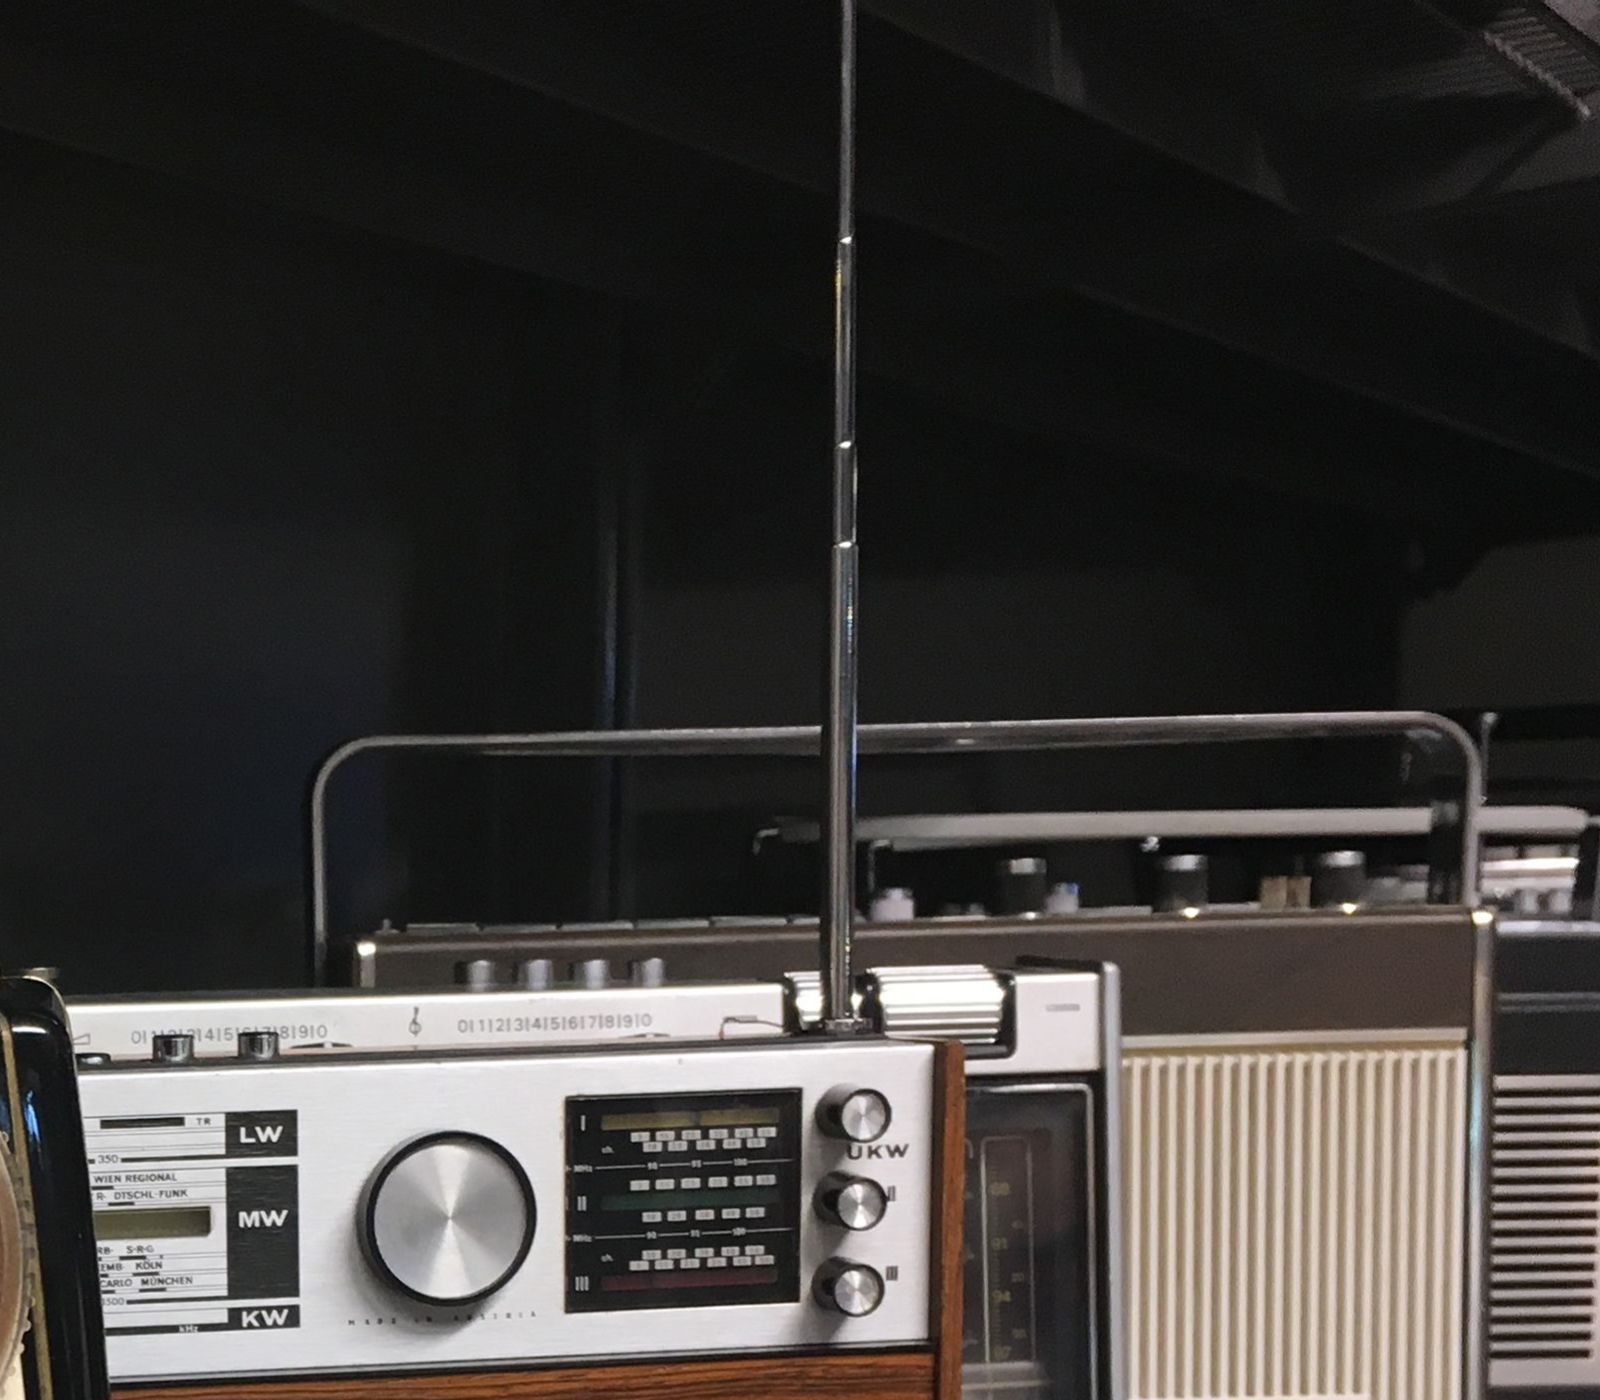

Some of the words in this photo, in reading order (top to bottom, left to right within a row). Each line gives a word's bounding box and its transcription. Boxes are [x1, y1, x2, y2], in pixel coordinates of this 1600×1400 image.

[240, 1125, 284, 1144] LW
[97, 1154, 119, 1165] 350
[847, 1143, 910, 1161] UKW
[93, 1174, 122, 1184] WIEN
[125, 1172, 178, 1183] REGIONAL
[238, 1209, 289, 1228] MW
[100, 1278, 133, 1288] CARLO
[141, 1276, 193, 1287] MÜNCHEN
[241, 1308, 289, 1328] KW
